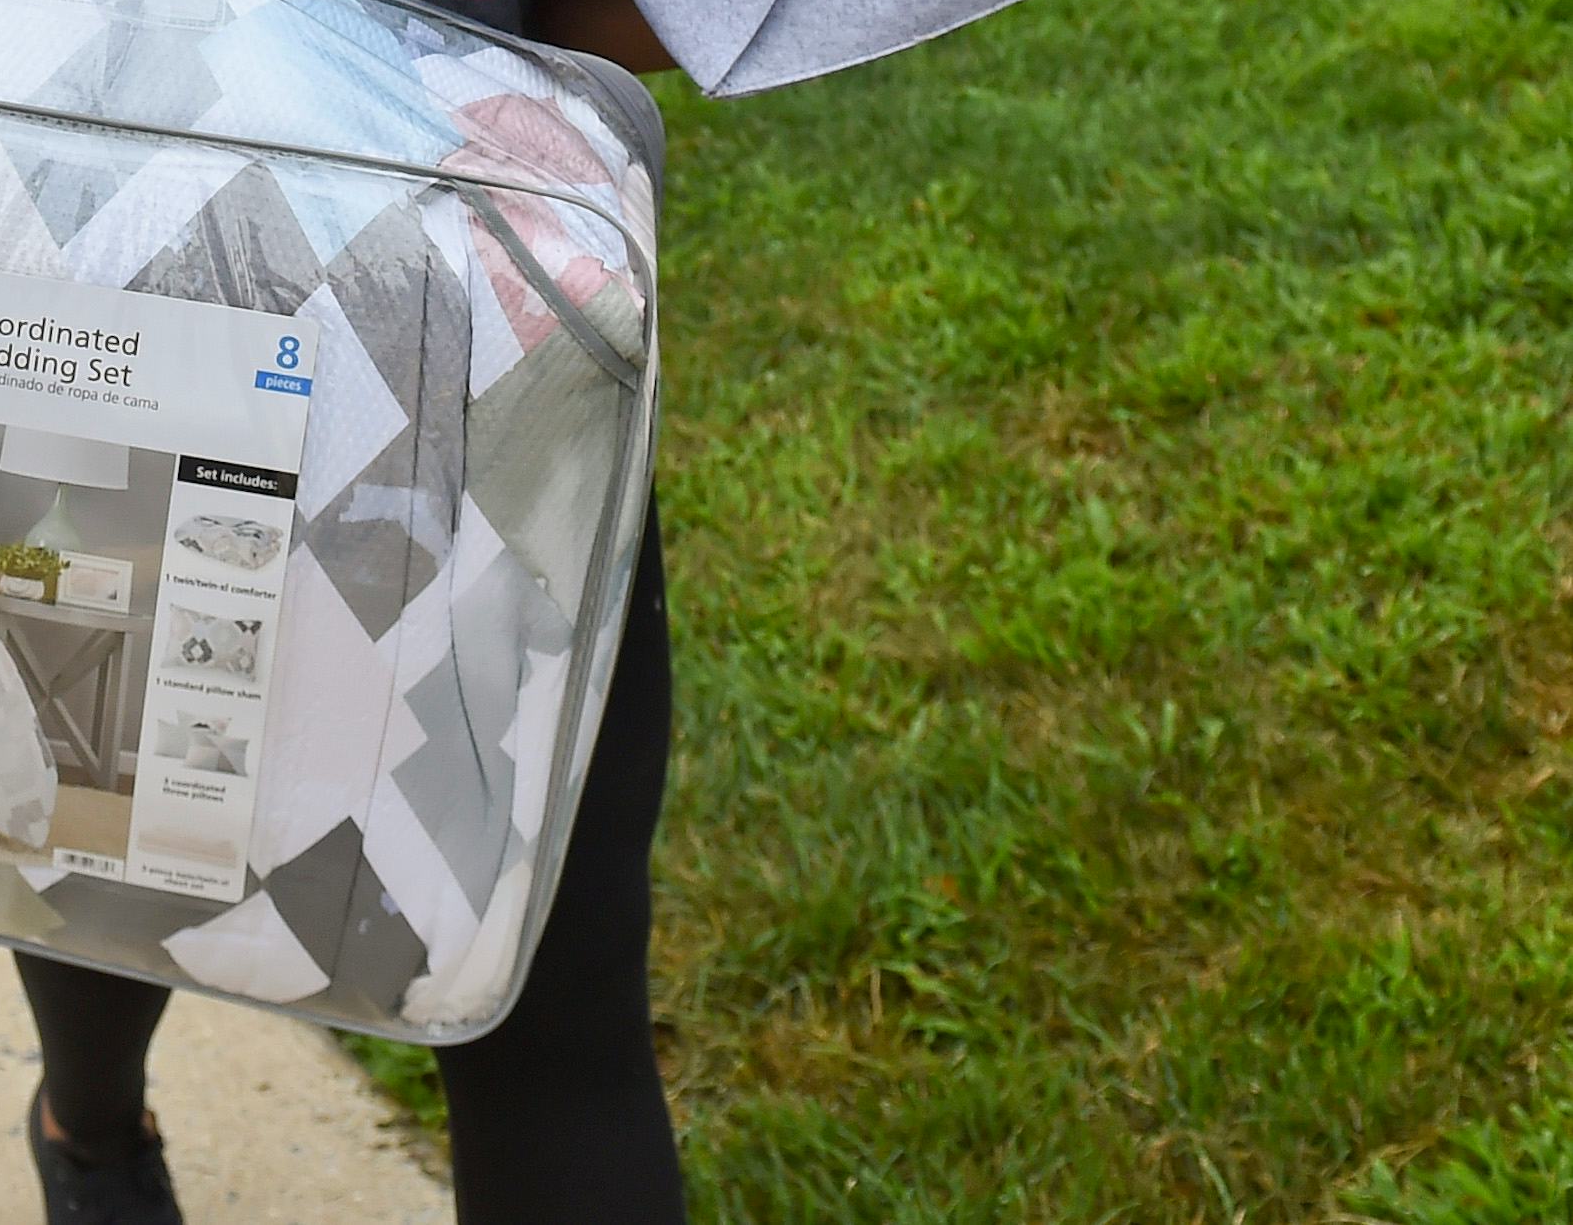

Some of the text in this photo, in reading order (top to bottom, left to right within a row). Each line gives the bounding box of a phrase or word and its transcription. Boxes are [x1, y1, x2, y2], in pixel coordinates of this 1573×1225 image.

[276, 336, 301, 370] 8
[87, 359, 133, 387] Set
[265, 376, 302, 392] pieces
[47, 381, 65, 396] de
[68, 387, 98, 405] ropa
[102, 390, 120, 405] de
[123, 396, 159, 412] cama
[196, 466, 279, 491] Set includes:
[231, 586, 277, 600] comforter
